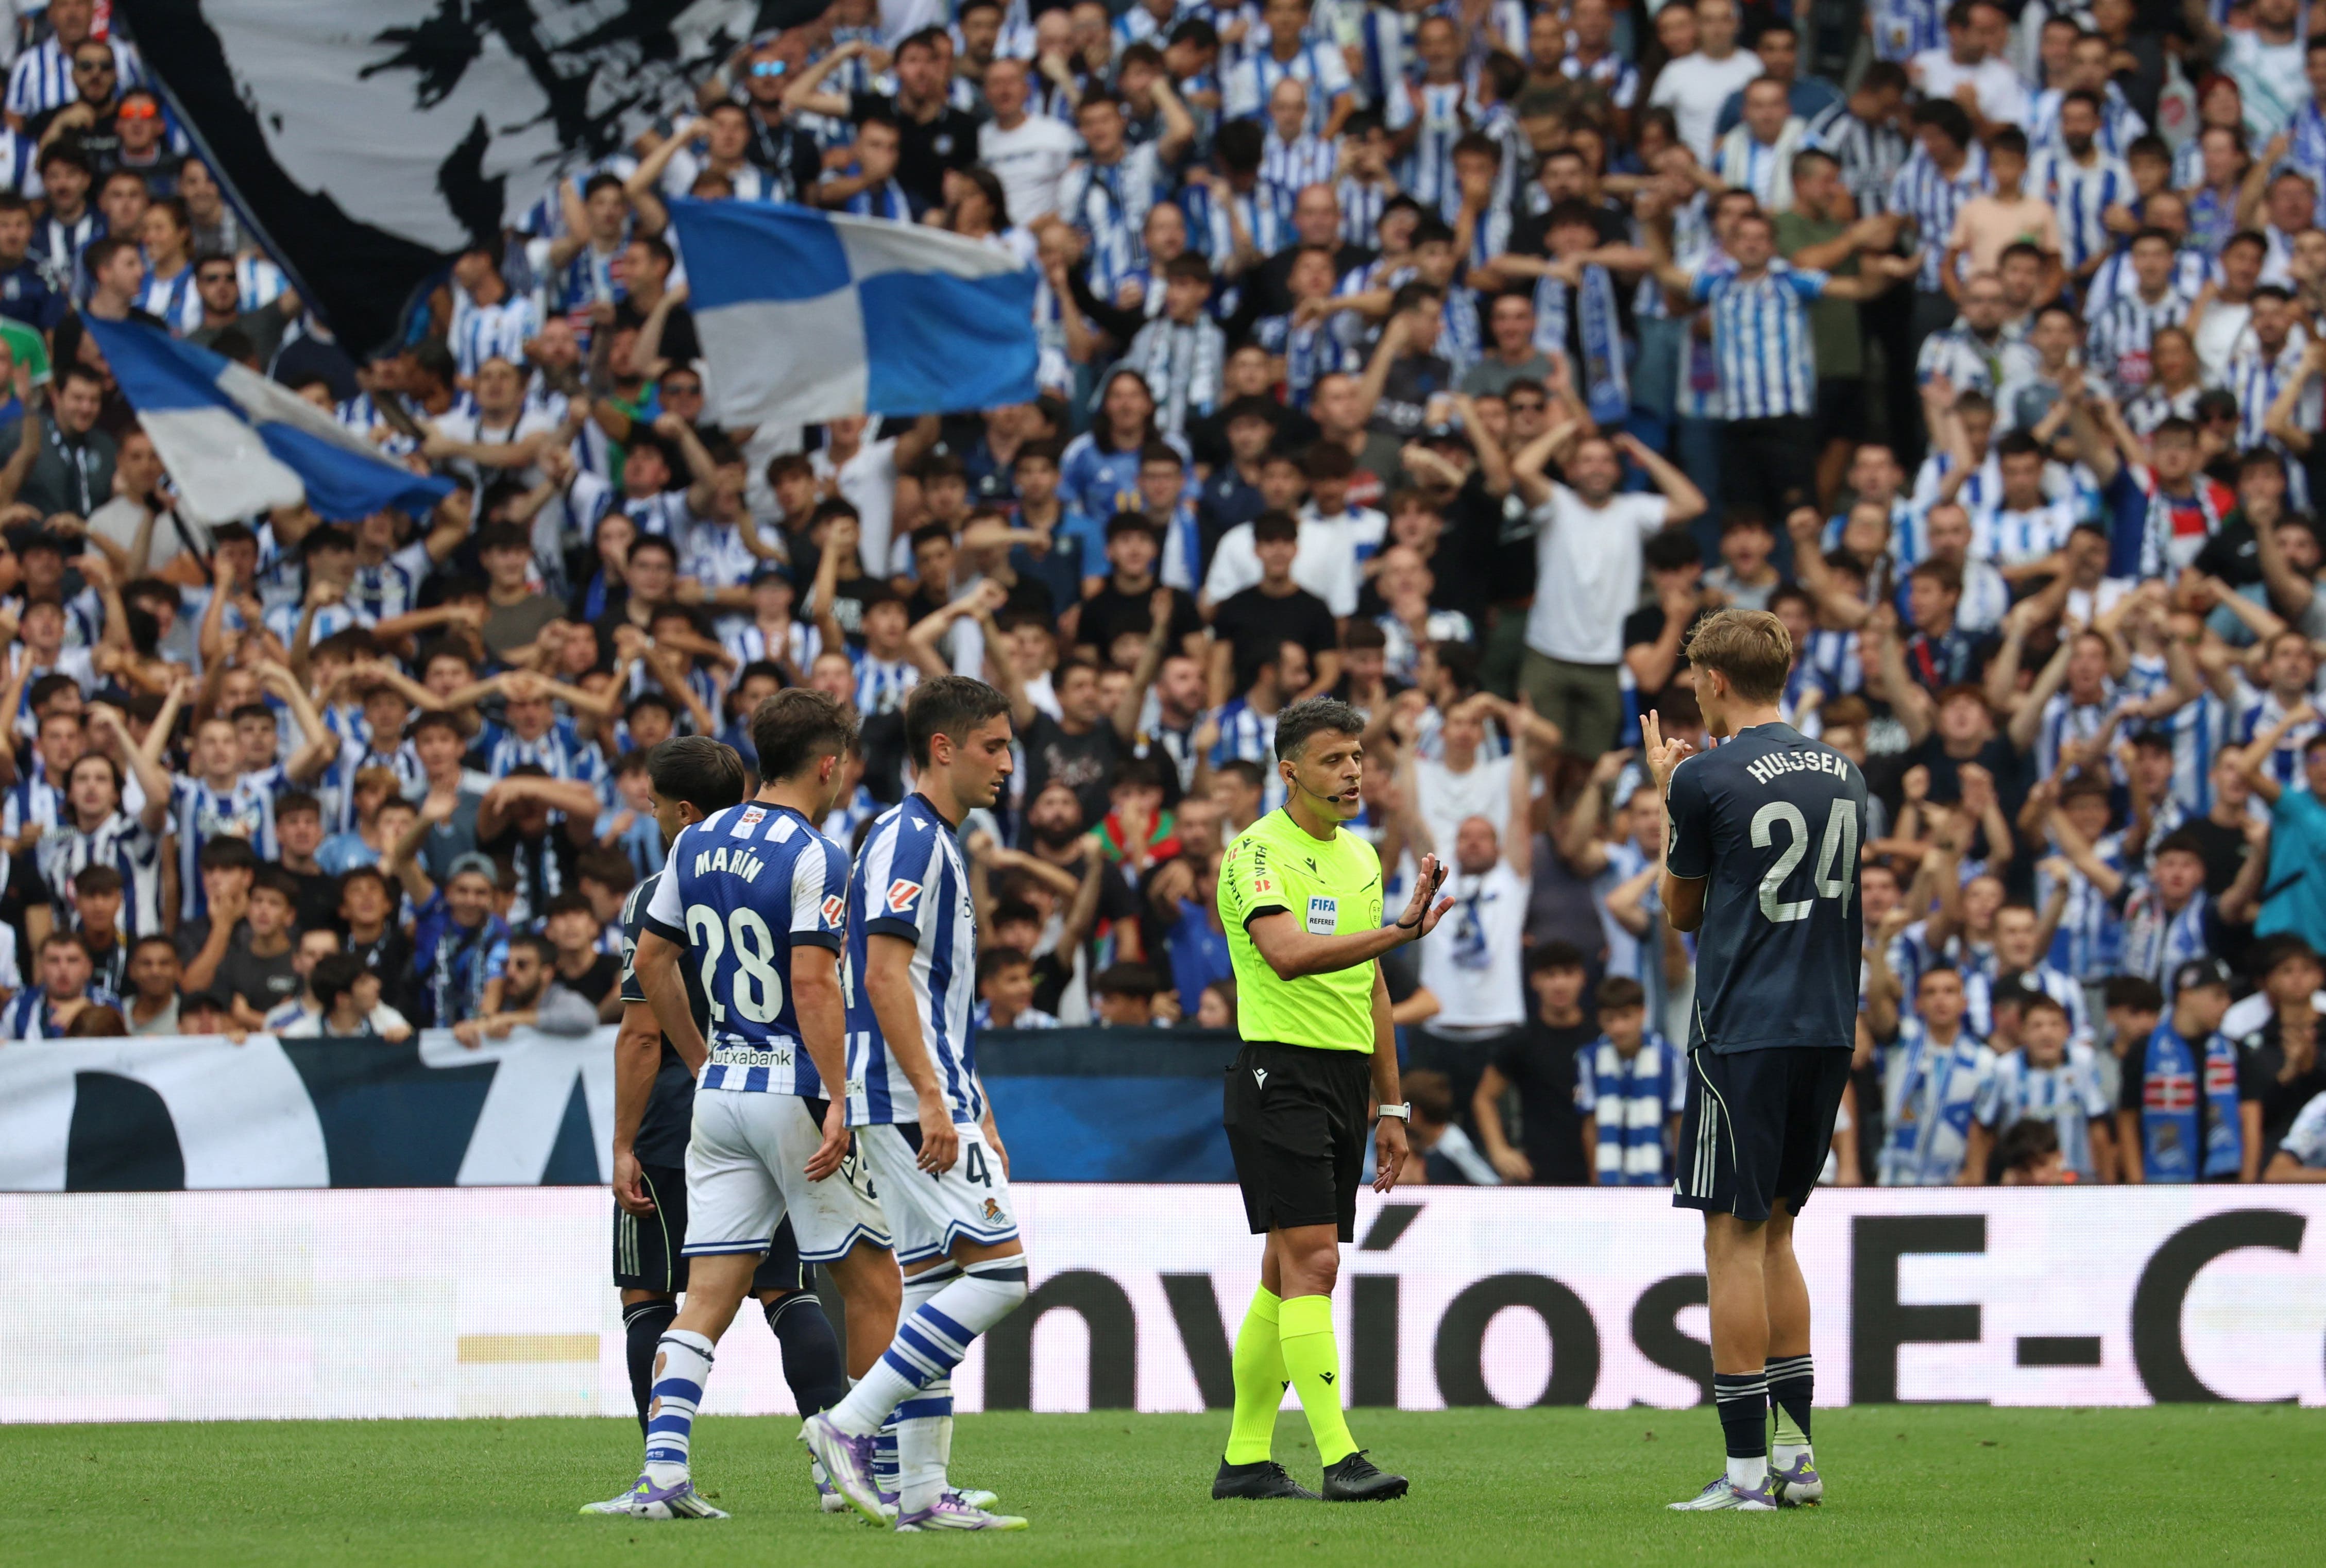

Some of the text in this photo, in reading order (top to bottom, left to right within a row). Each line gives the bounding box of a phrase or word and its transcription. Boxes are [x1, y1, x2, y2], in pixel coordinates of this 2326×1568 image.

[1746, 751, 1848, 785] HUIJSEN
[695, 846, 765, 883] MARÍN
[1750, 798, 1858, 924] 24
[1310, 917, 1335, 926] REFEREE
[1311, 898, 1335, 912] FIFA
[686, 904, 783, 1024] 28
[966, 1142, 992, 1188] 4
[815, 1203, 2326, 1410] nvíos E-C
